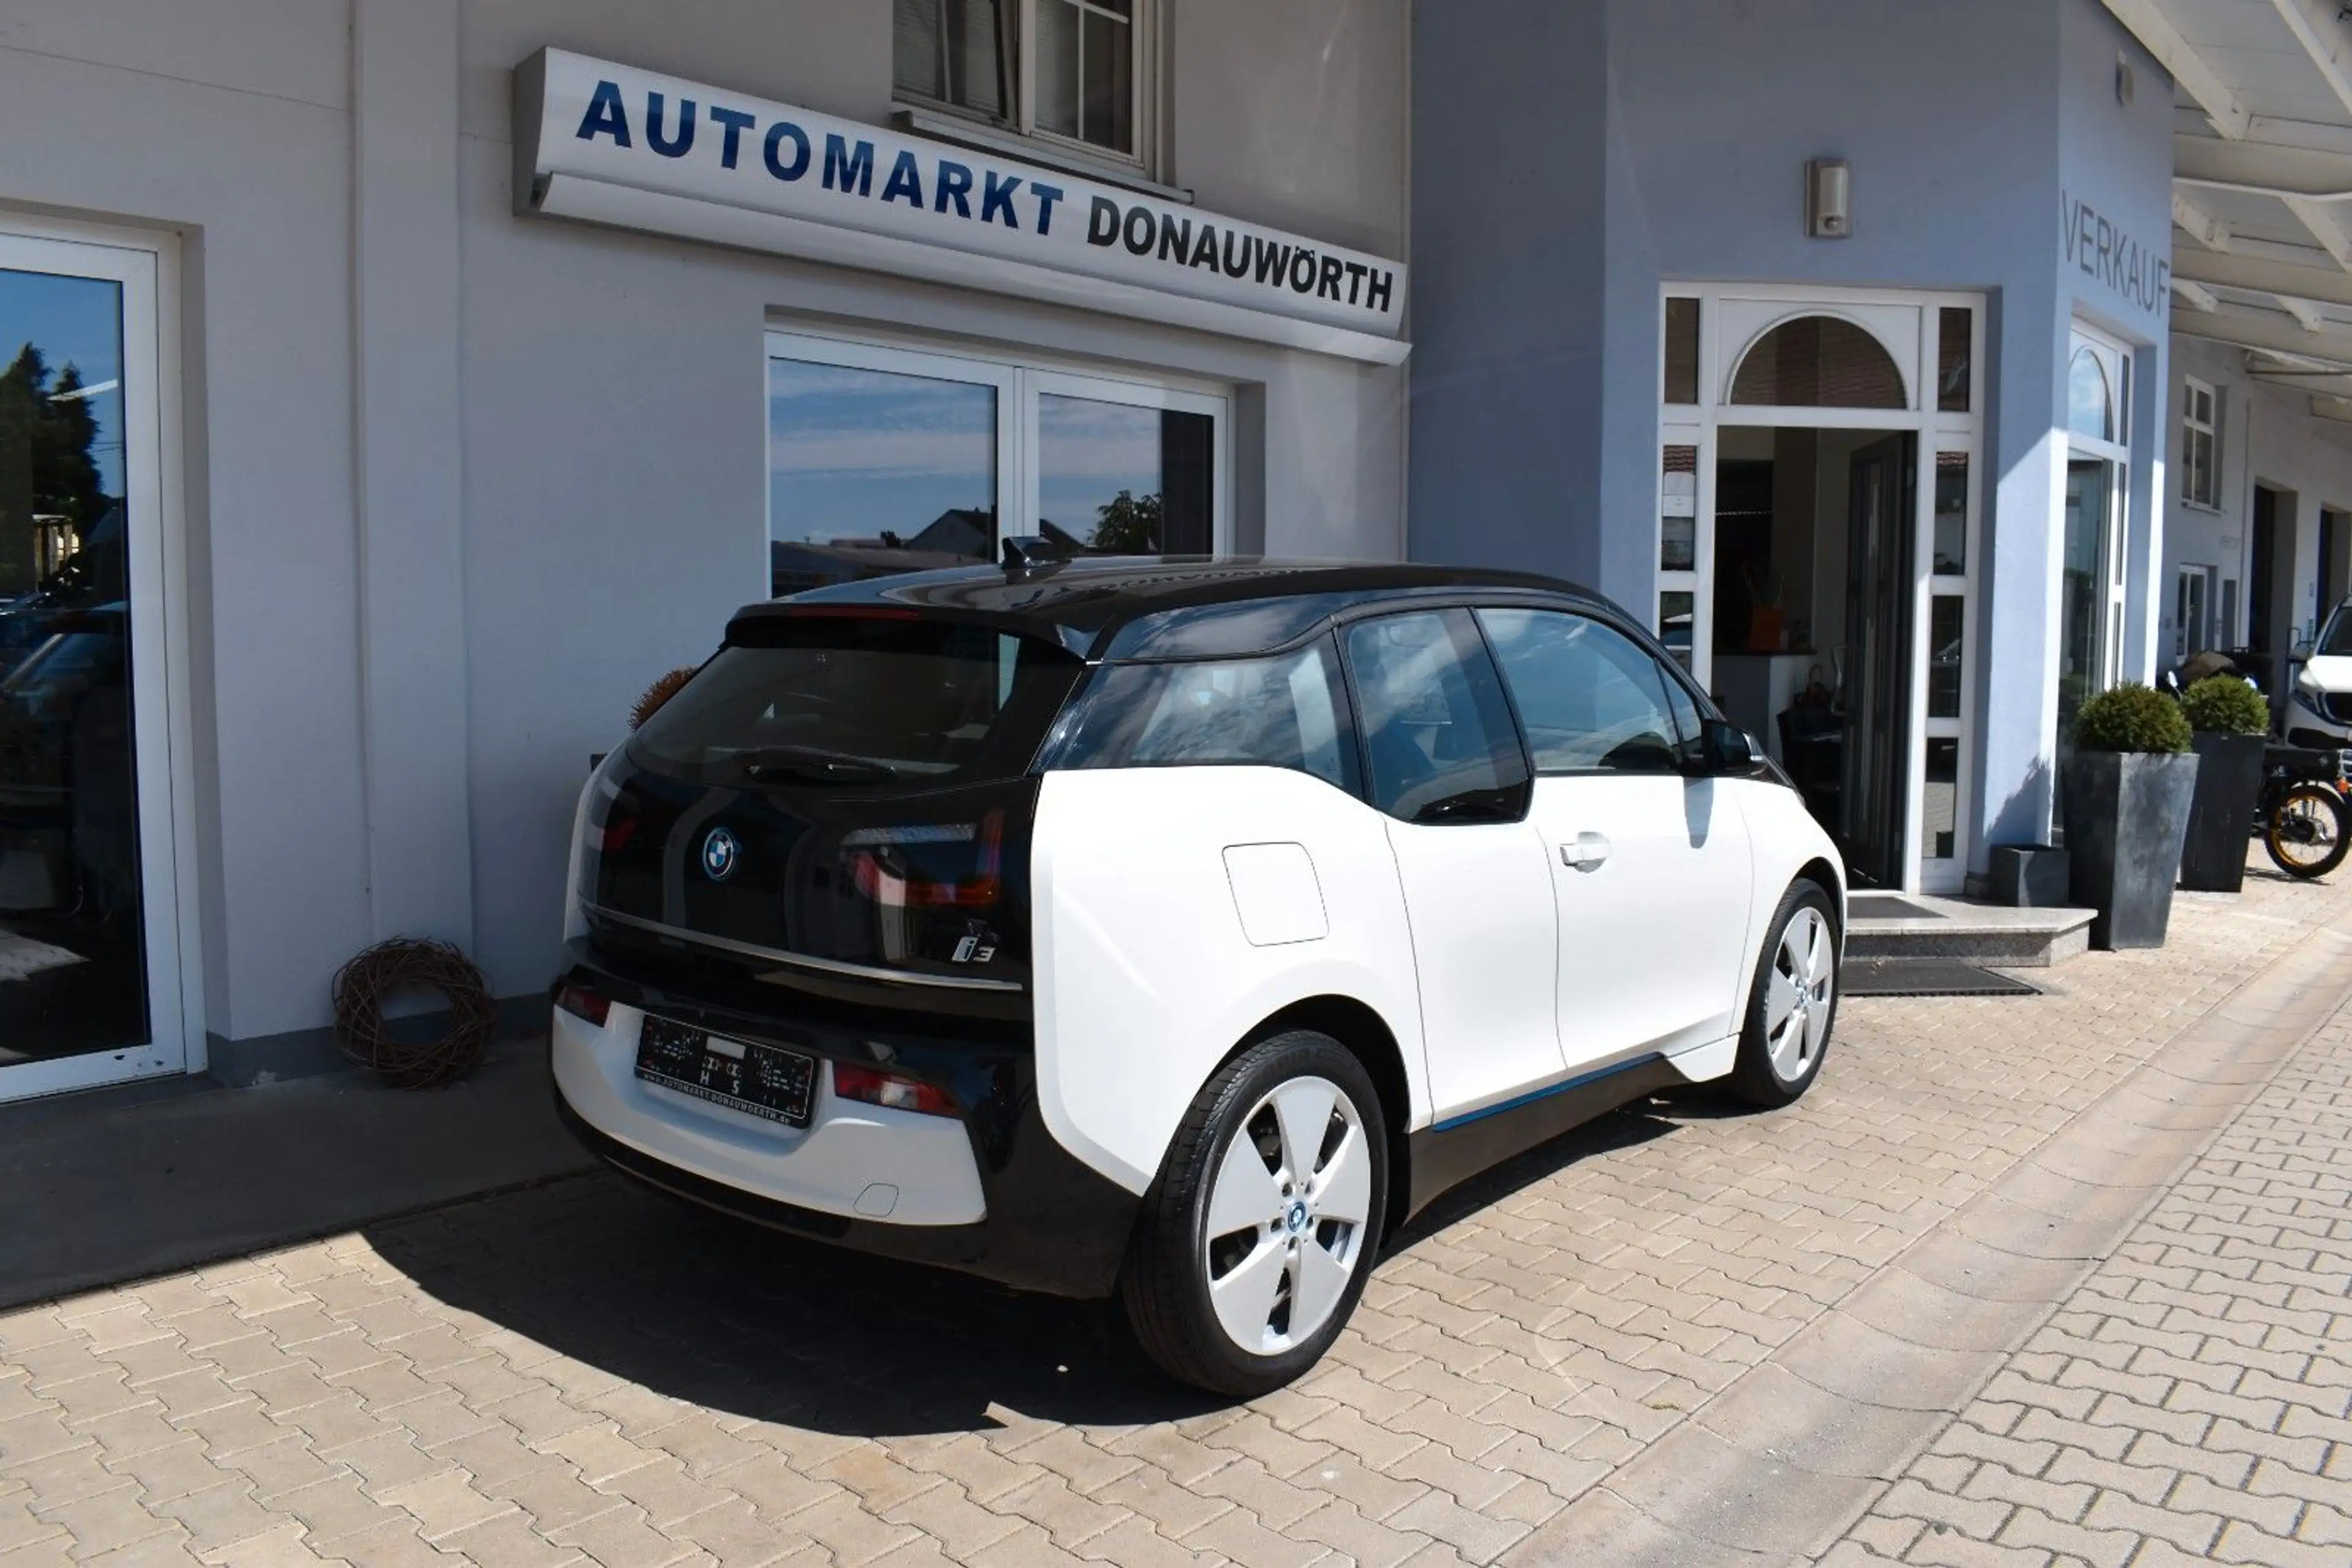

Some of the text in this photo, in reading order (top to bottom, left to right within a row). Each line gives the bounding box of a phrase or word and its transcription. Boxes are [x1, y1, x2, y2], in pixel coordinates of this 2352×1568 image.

[576, 80, 1393, 312] AUTOMARKT DONAUWÖRTH
[2062, 189, 2169, 317] VERKAUF
